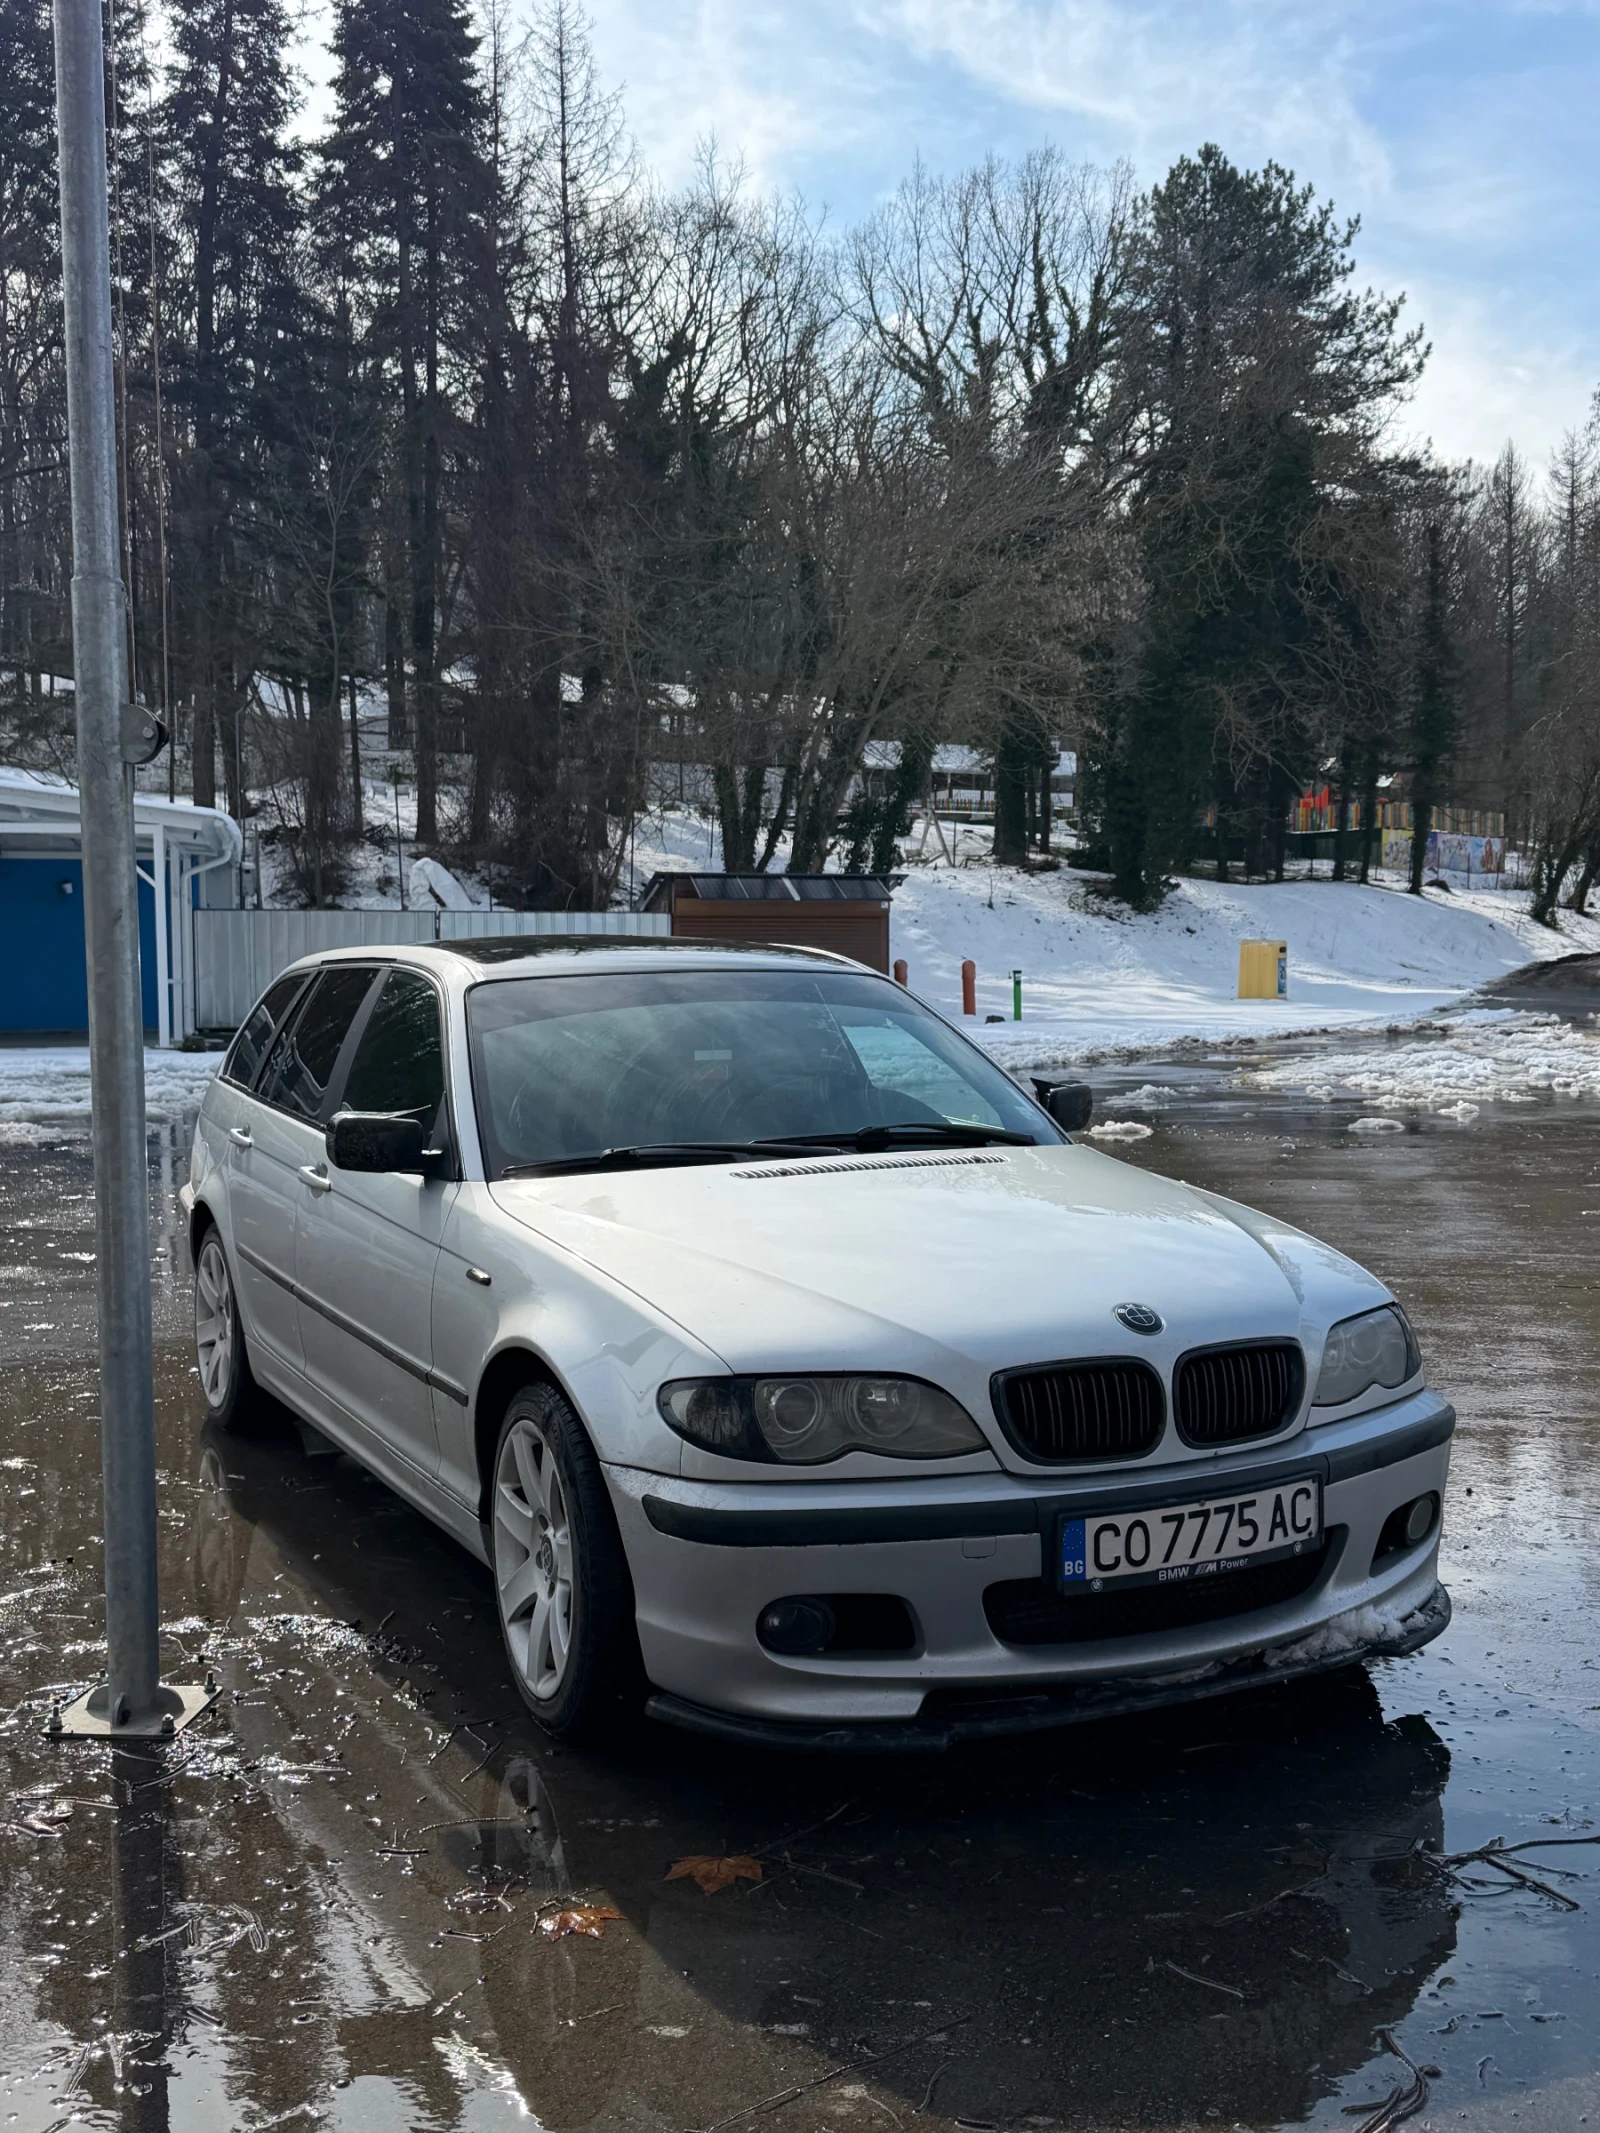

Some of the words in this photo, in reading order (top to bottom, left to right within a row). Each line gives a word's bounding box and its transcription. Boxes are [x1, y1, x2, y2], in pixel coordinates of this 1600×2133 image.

[1093, 1519, 1151, 1572] CO
[1161, 1499, 1259, 1563] 7775
[1268, 1487, 1312, 1542] AC
[1064, 1560, 1084, 1576] BG
[1158, 1566, 1190, 1581] BMW
[1220, 1558, 1249, 1570] Power
